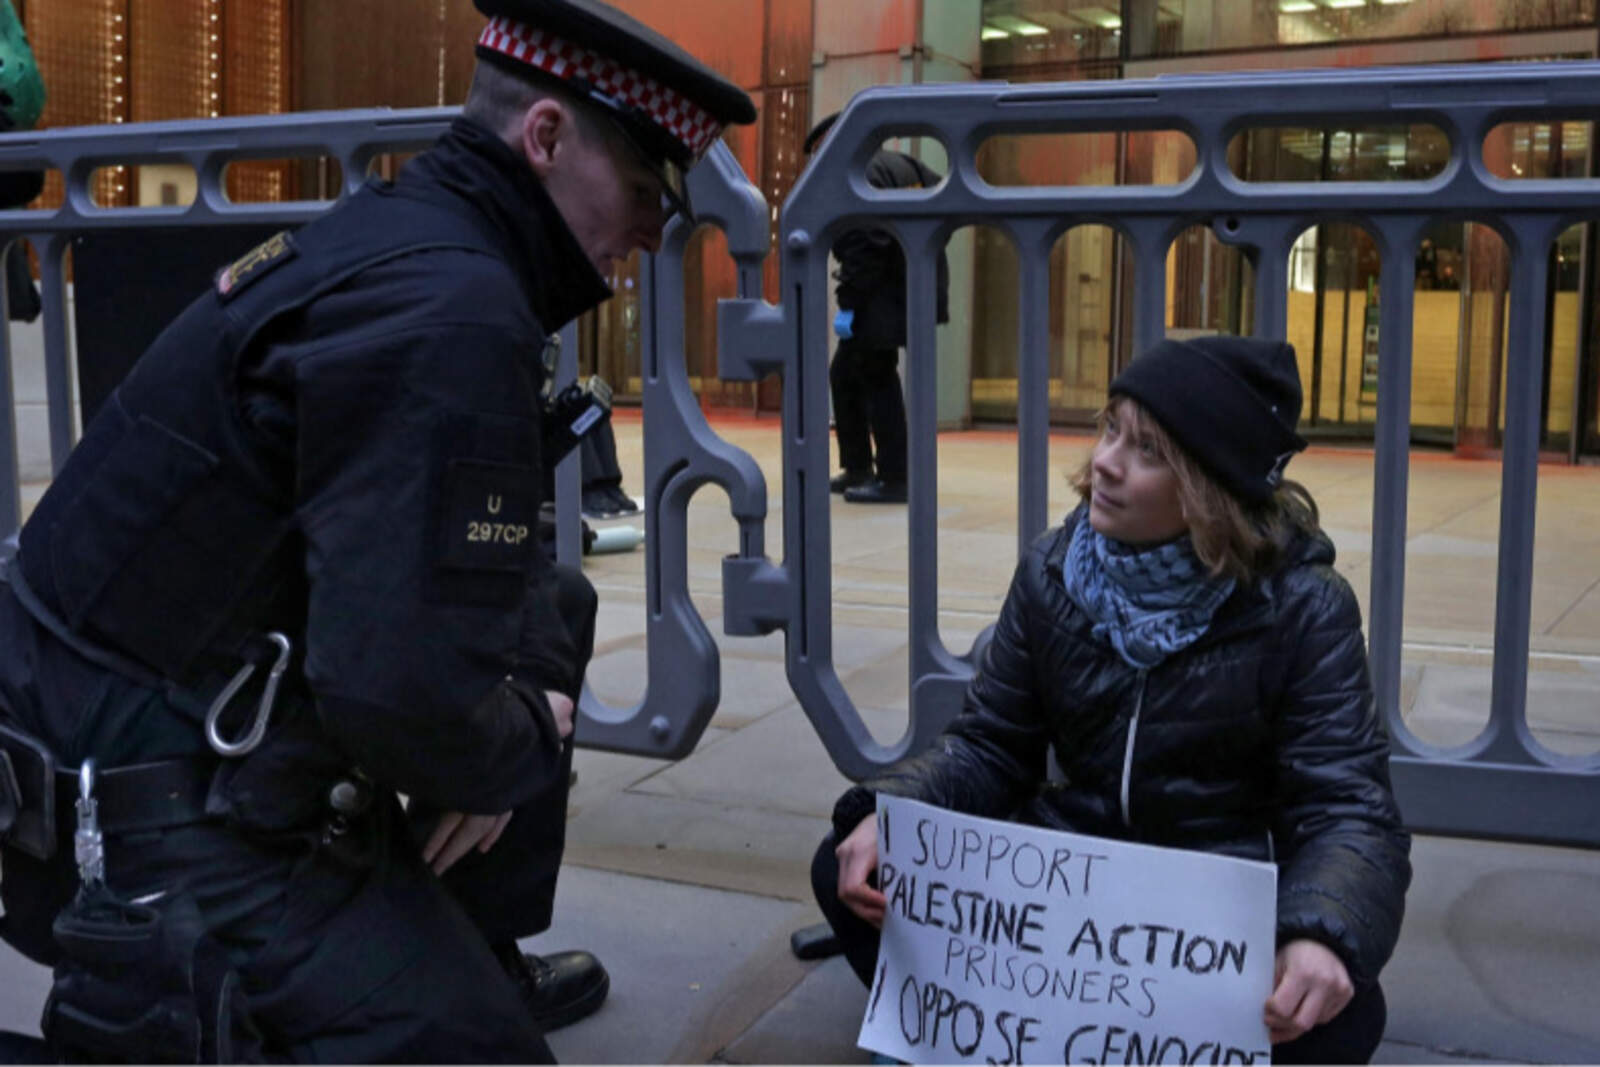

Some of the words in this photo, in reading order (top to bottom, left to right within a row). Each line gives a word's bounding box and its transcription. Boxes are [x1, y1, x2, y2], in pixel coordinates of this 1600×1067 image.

[467, 521, 529, 544] 297CP
[486, 494, 502, 514] U
[882, 805, 891, 854] I
[912, 818, 1109, 896] SUPPORT
[879, 862, 1048, 954] PALESTINE
[1067, 917, 1248, 975] ACTION
[867, 960, 888, 1024] I
[899, 974, 1042, 1066] OPPOSE
[1063, 1024, 1270, 1066] GENO
[944, 937, 1159, 1018] PRISONERS
